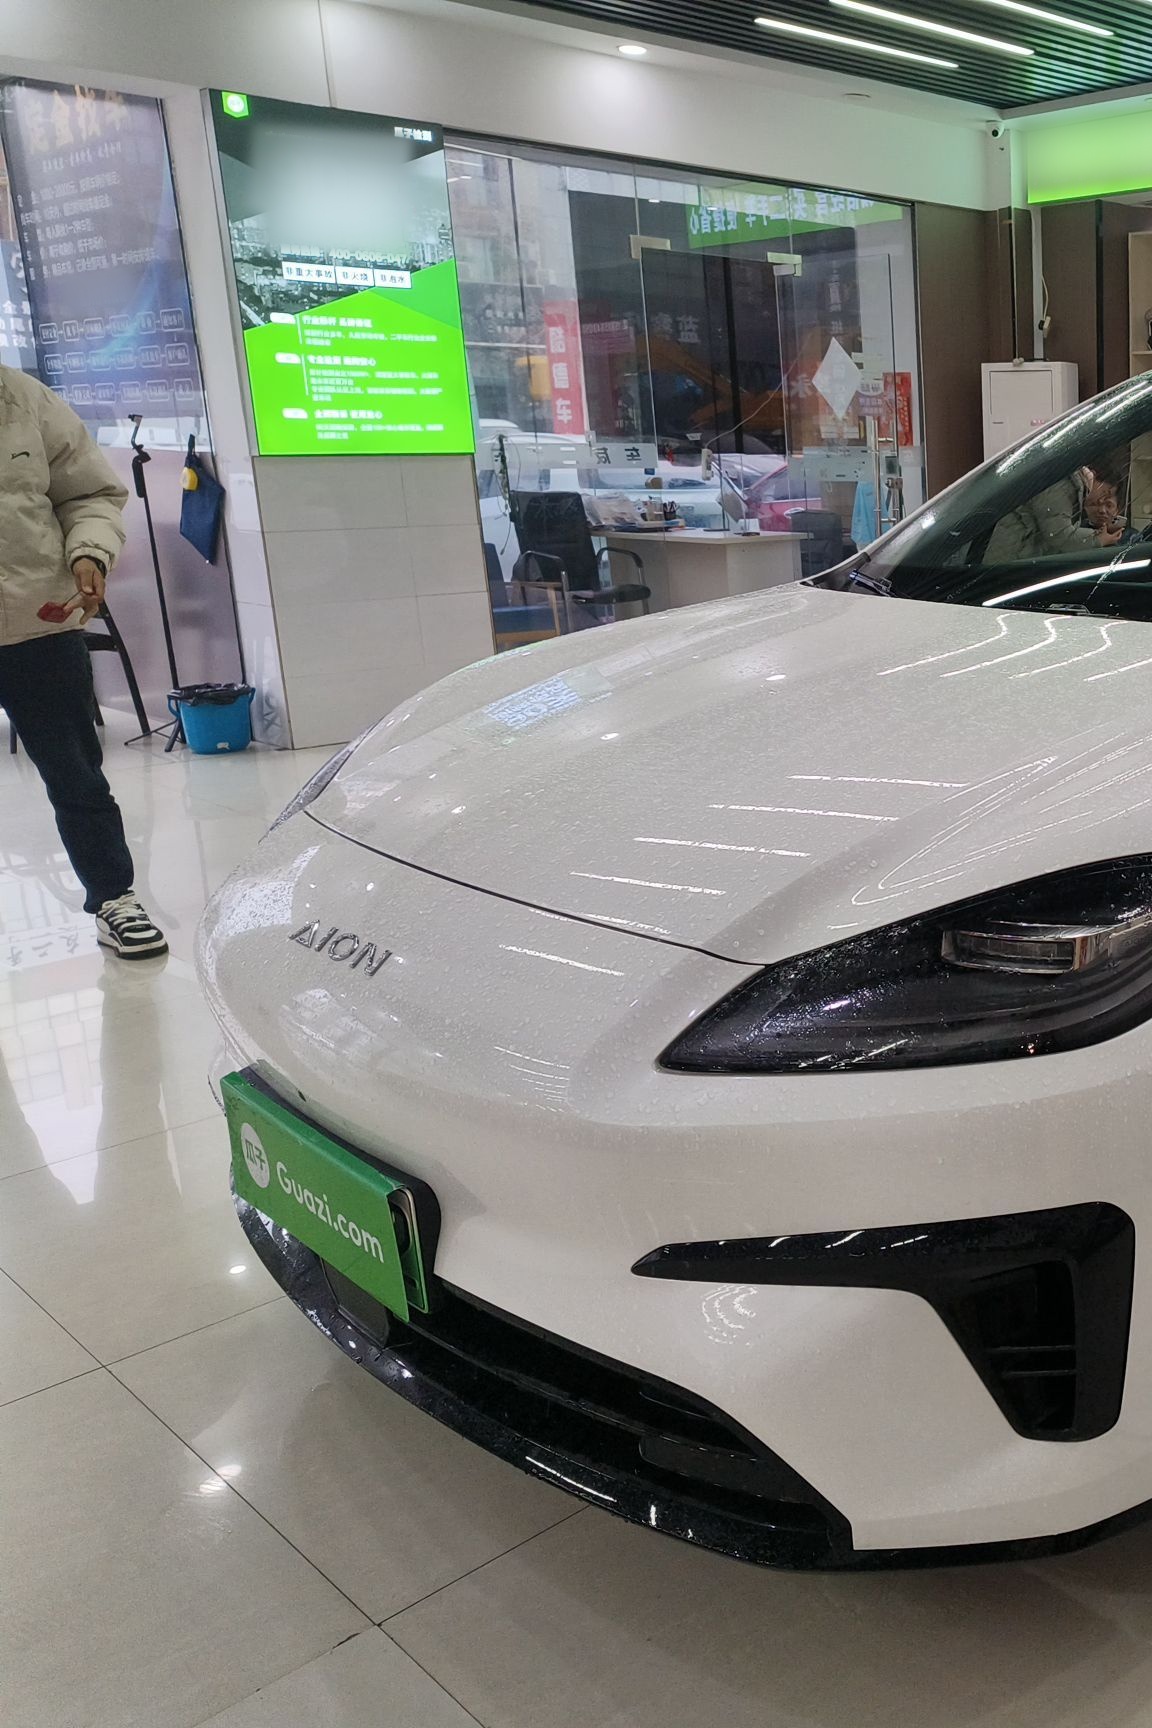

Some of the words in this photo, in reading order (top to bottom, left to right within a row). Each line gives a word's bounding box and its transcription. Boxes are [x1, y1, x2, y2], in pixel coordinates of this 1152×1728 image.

[285, 265, 333, 280] 非重大事故
[288, 919, 393, 977] AION
[244, 1138, 266, 1171] 瓜子
[276, 1161, 385, 1264] Guazi.com
